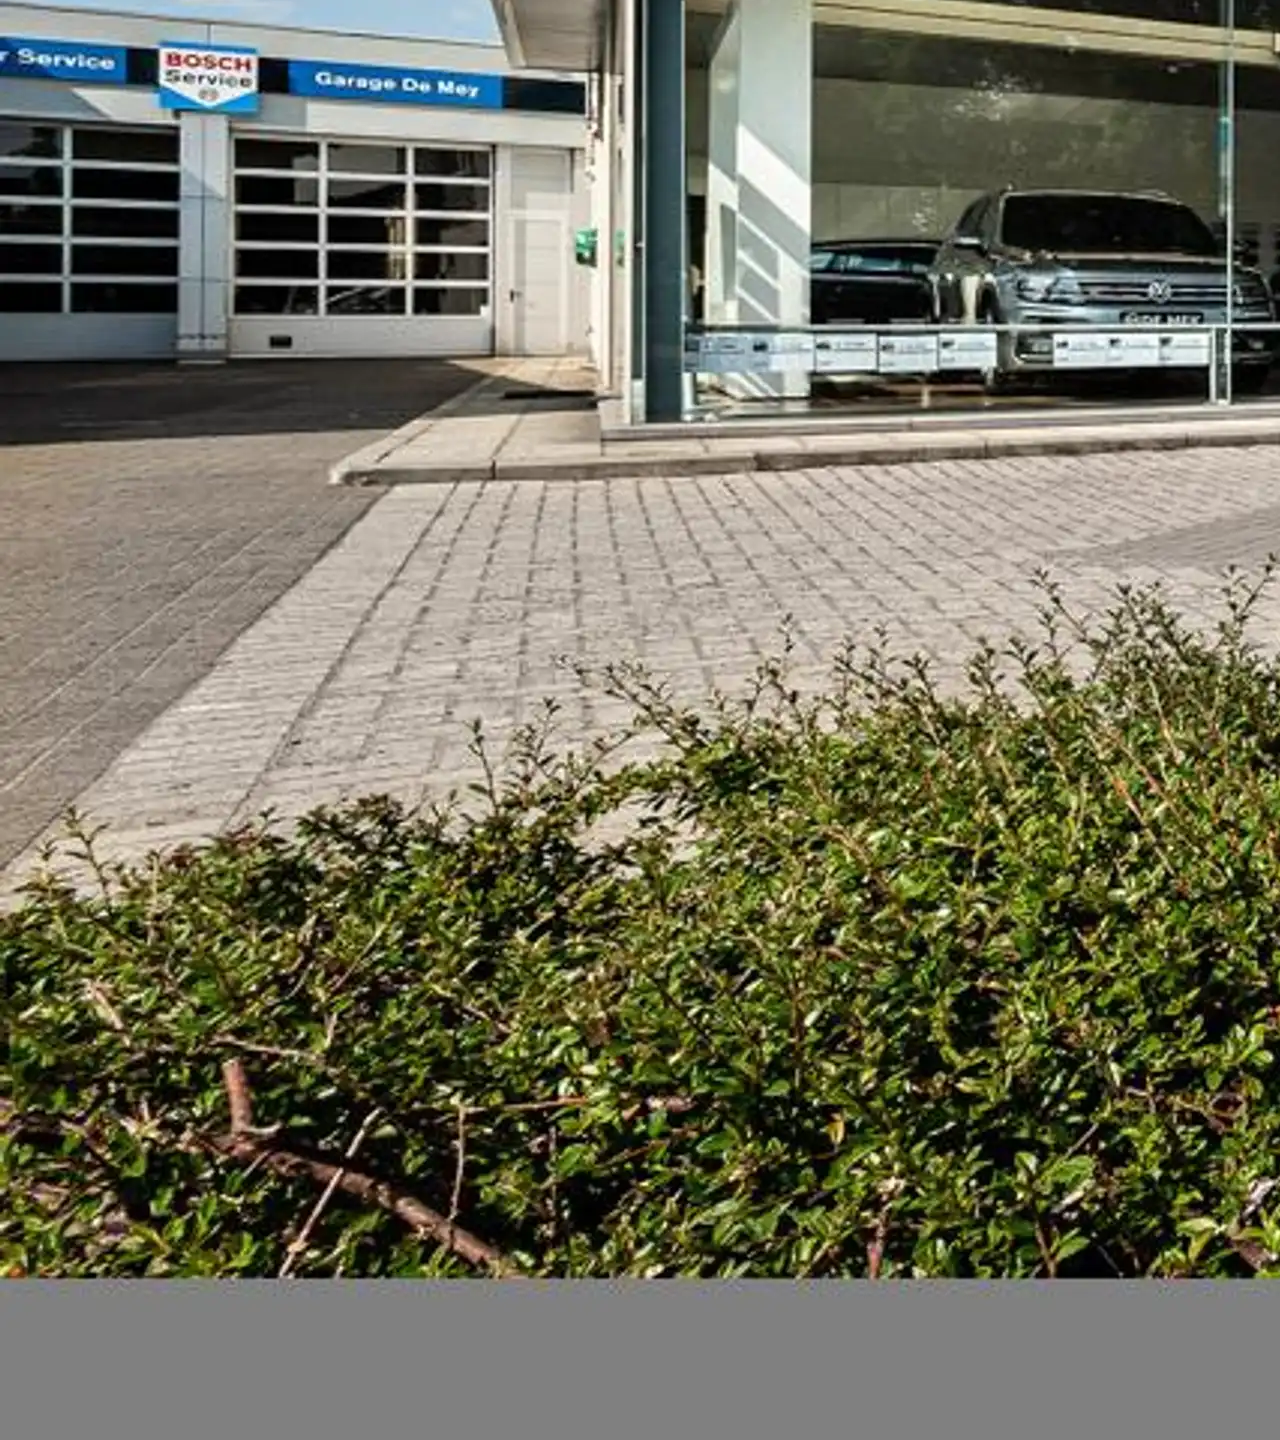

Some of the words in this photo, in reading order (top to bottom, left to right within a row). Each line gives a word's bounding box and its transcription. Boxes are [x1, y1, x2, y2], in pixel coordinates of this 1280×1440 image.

[17, 47, 116, 71] Service
[166, 53, 252, 72] BOSCH
[165, 69, 253, 88] Service
[314, 71, 396, 92] Garage
[401, 77, 432, 94] De
[437, 80, 480, 99] Mey
